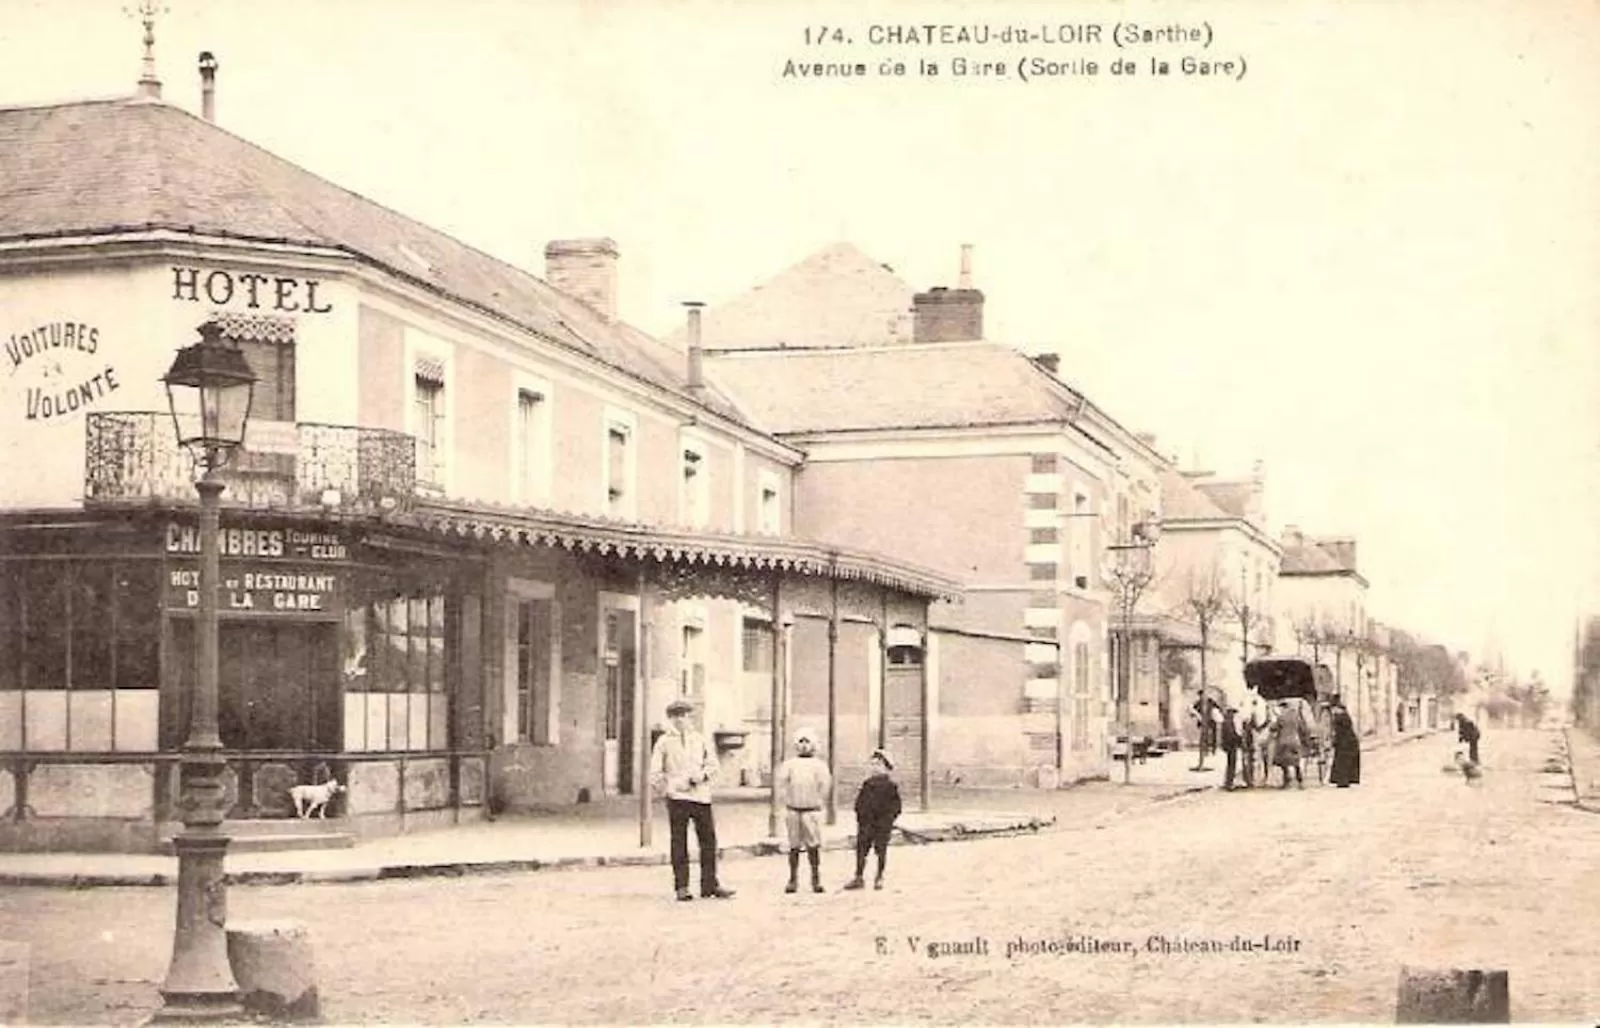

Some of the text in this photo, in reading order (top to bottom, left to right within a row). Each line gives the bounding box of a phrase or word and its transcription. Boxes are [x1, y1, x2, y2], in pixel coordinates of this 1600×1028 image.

[171, 266, 334, 314] HOTEL
[5, 321, 100, 367] VOITURES
[244, 572, 336, 592] RESTAURANT
[230, 591, 254, 607] LA
[273, 592, 322, 610] GARE
